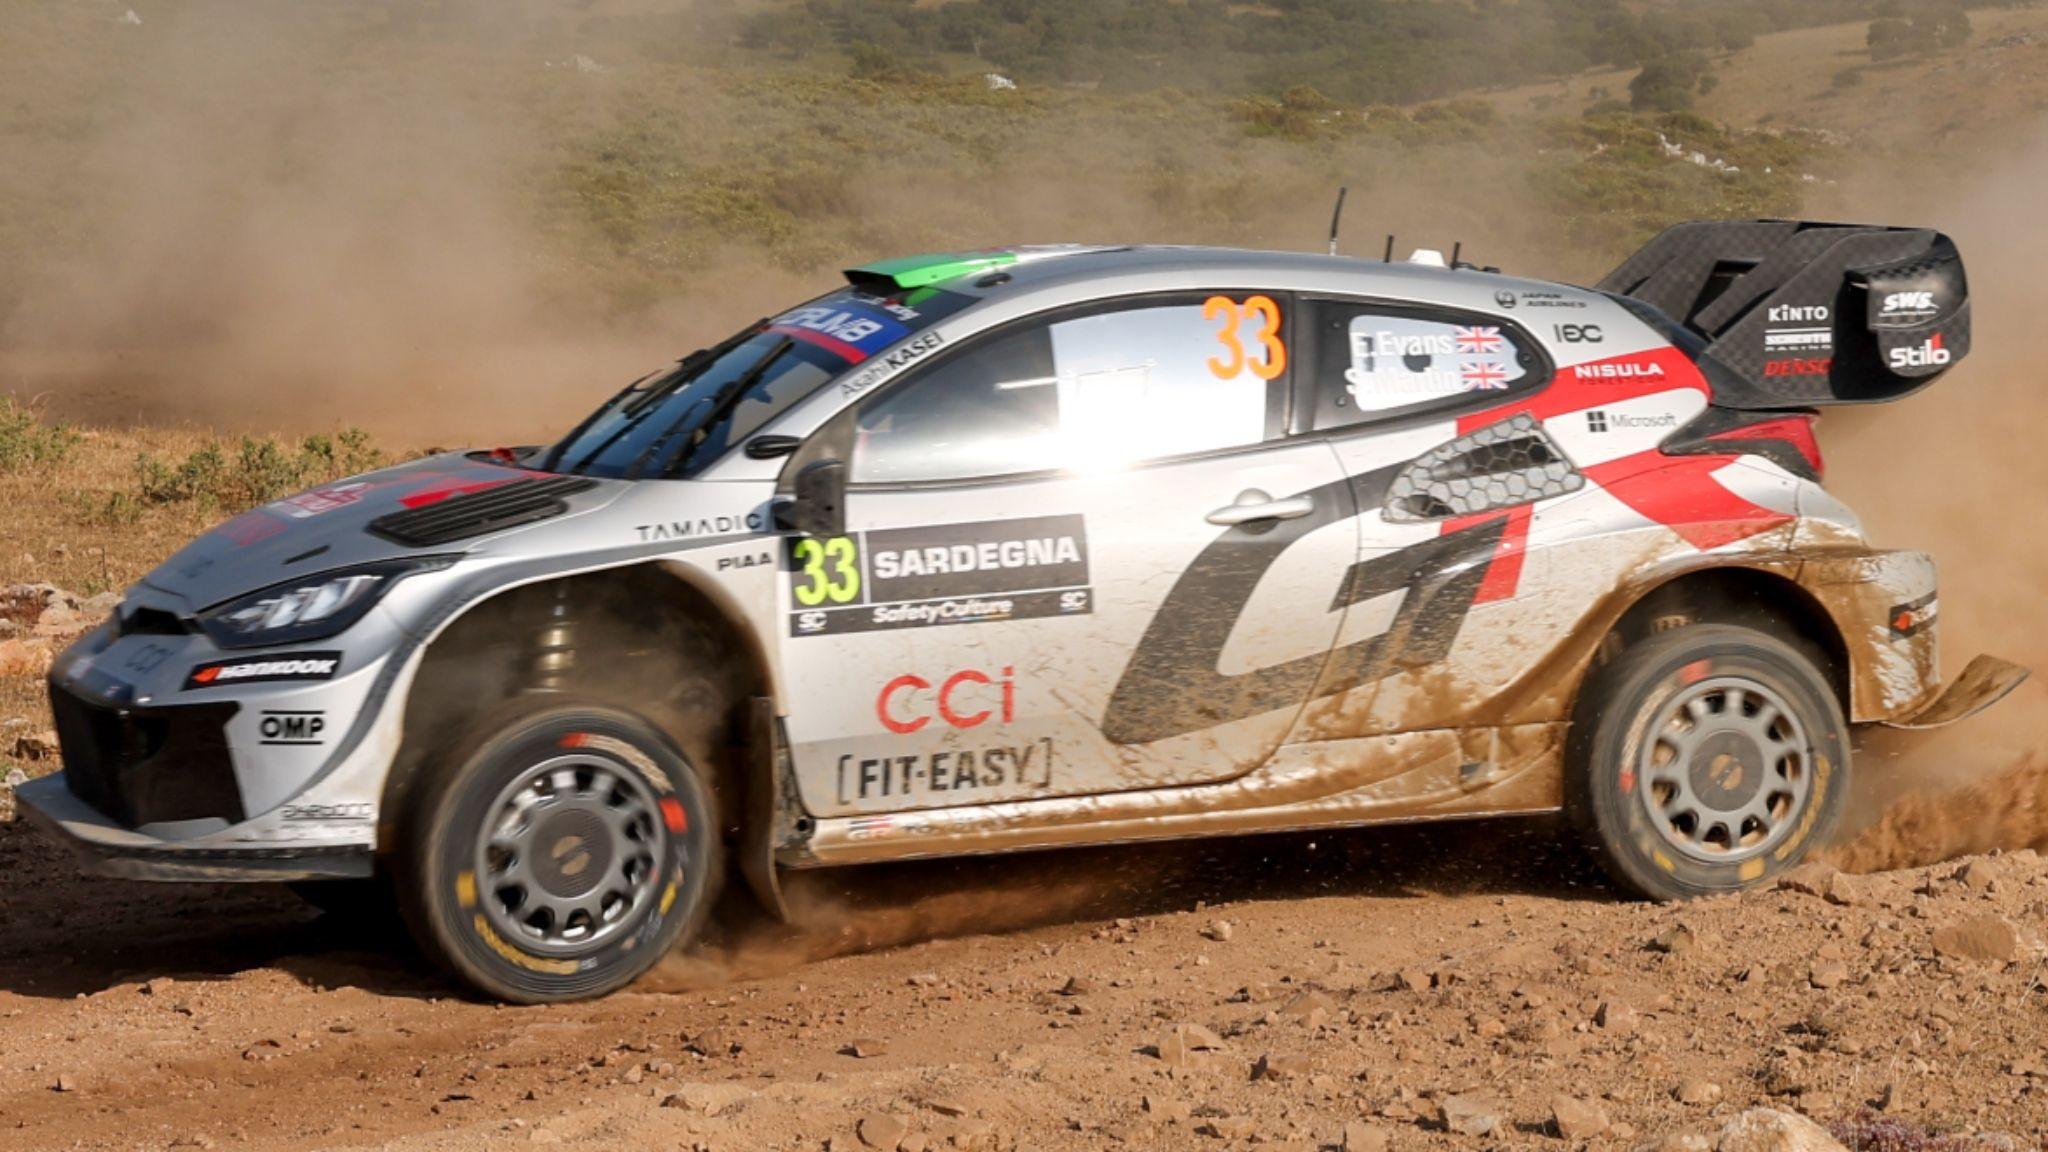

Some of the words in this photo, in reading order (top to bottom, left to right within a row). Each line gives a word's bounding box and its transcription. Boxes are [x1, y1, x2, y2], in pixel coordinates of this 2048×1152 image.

[884, 331, 944, 371] KASEI
[1202, 294, 1287, 381] 33
[1890, 334, 1950, 368] Stilo
[1573, 362, 1665, 379] NISULA
[1610, 413, 1678, 428] Microsoft
[636, 513, 762, 541] TAMADIC
[717, 553, 774, 571] PIAA
[794, 537, 862, 605] 33
[874, 536, 1081, 579] SARDEGNA
[798, 612, 828, 630] SC
[873, 598, 1014, 624] SafetyCulture
[1060, 591, 1088, 609] SC
[260, 716, 326, 739] OMP
